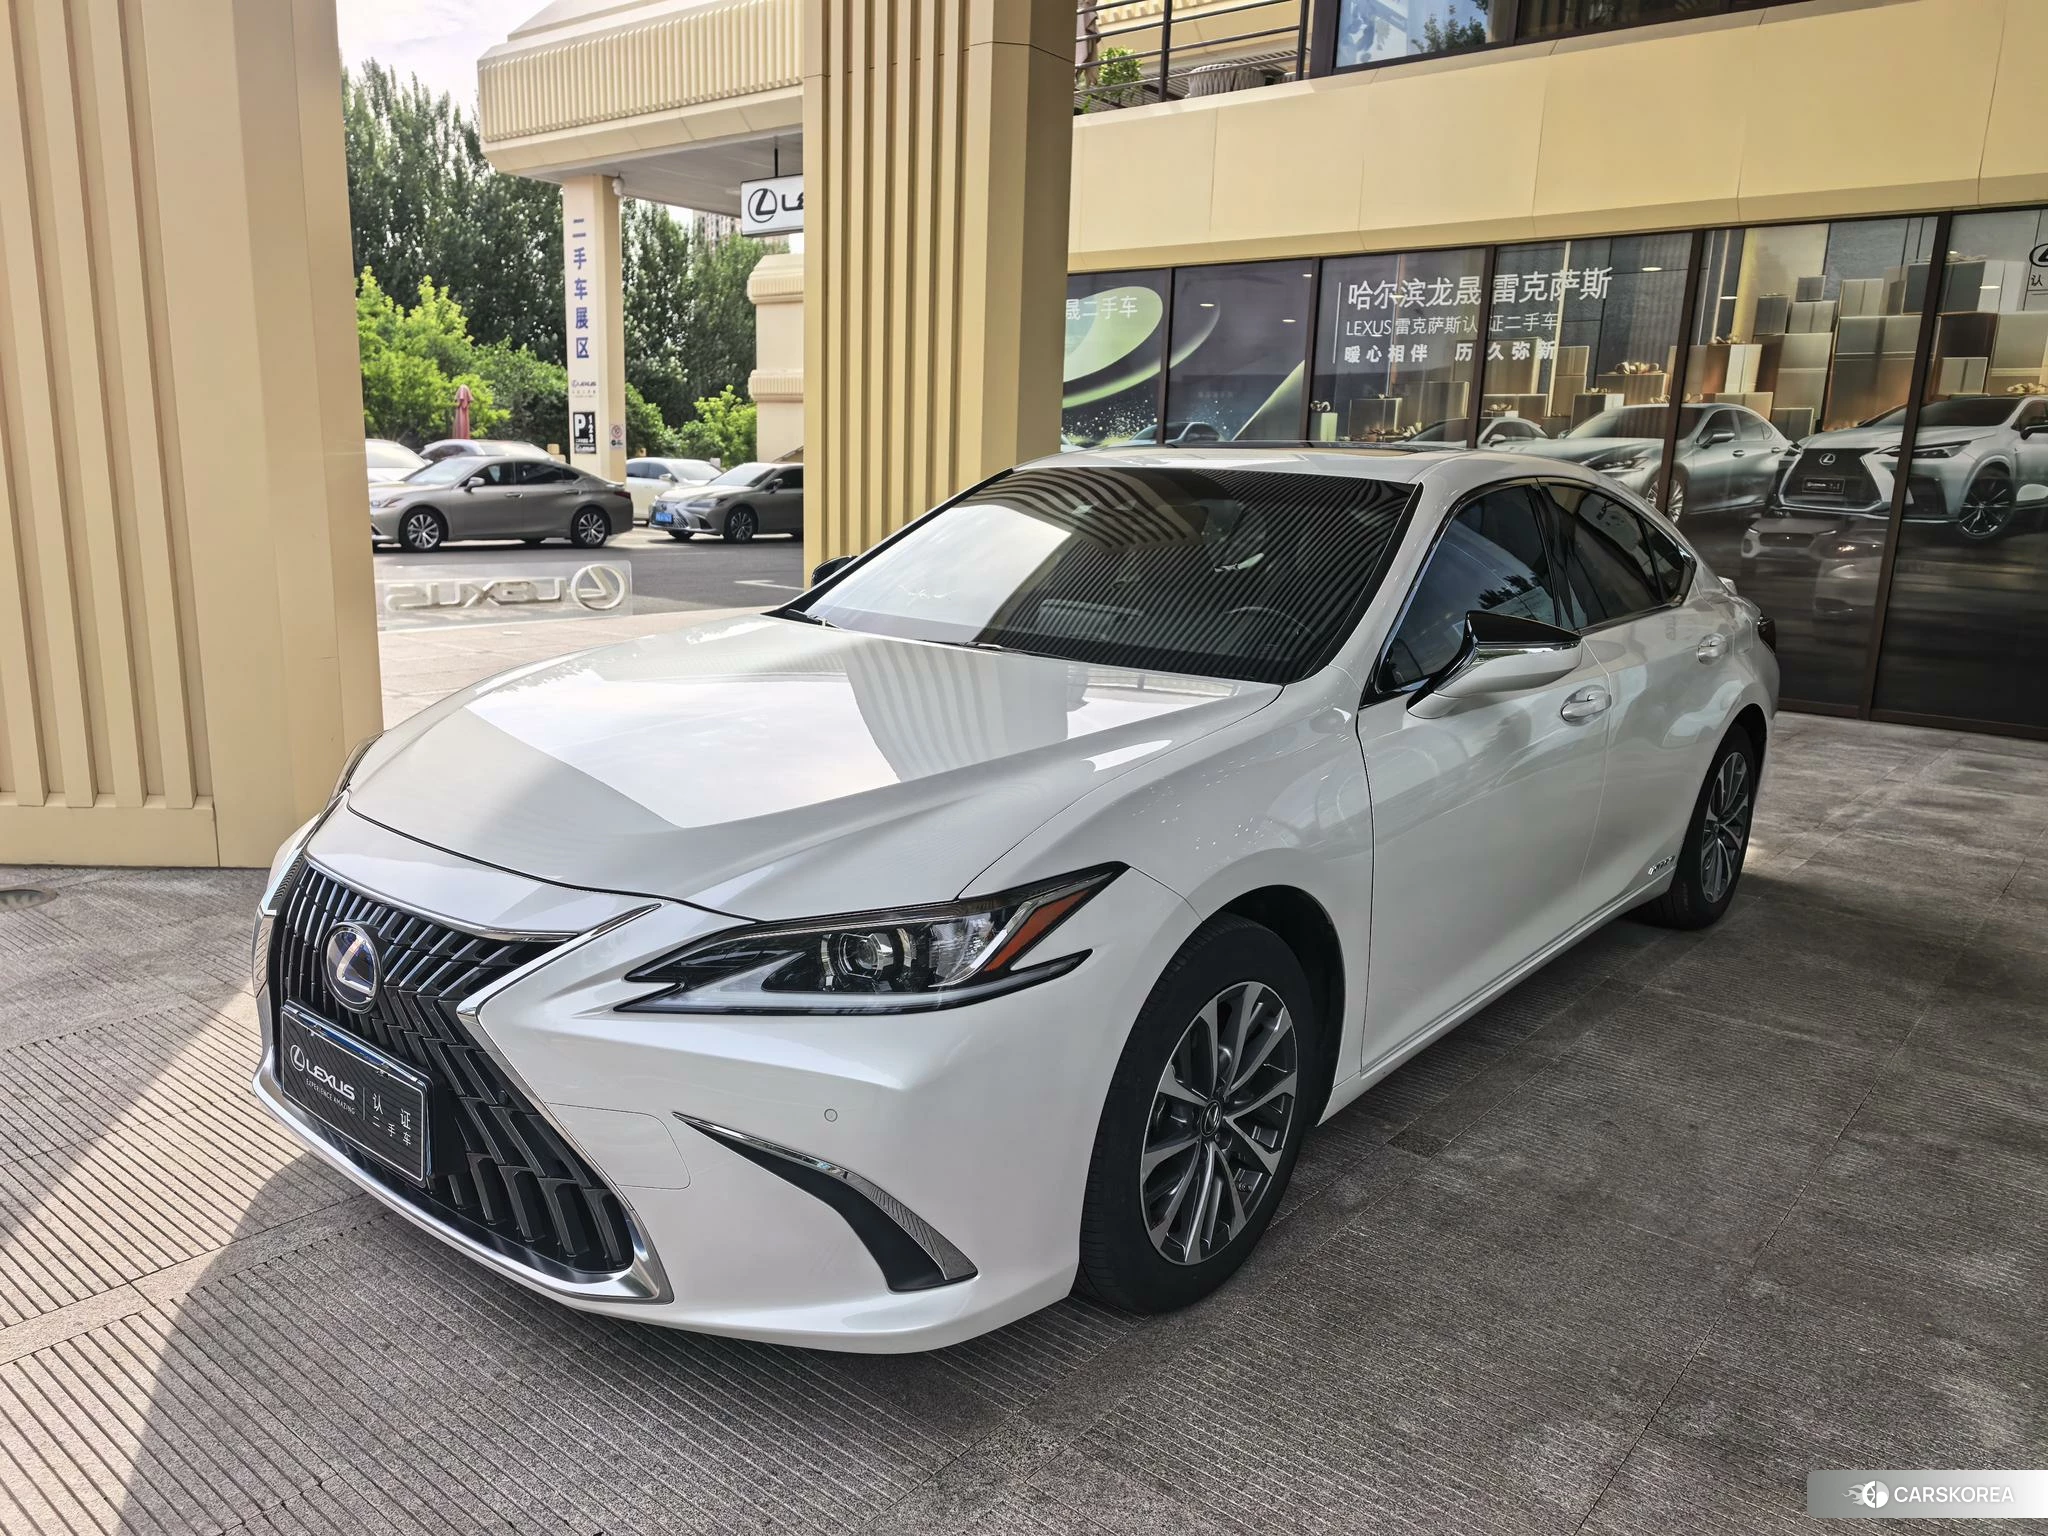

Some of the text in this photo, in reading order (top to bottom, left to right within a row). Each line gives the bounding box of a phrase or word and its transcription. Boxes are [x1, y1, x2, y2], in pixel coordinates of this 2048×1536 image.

[572, 218, 589, 359] 二手车展区
[1348, 266, 1613, 310] 哈尔滨龙晟 雷克萨斯
[1346, 319, 1392, 337] LEXUS
[1344, 343, 1428, 363] 暖心相伴
[574, 414, 586, 437] P
[306, 1059, 355, 1101] LEXUS
[306, 1078, 356, 1115] EXPERIENCE AMAZING
